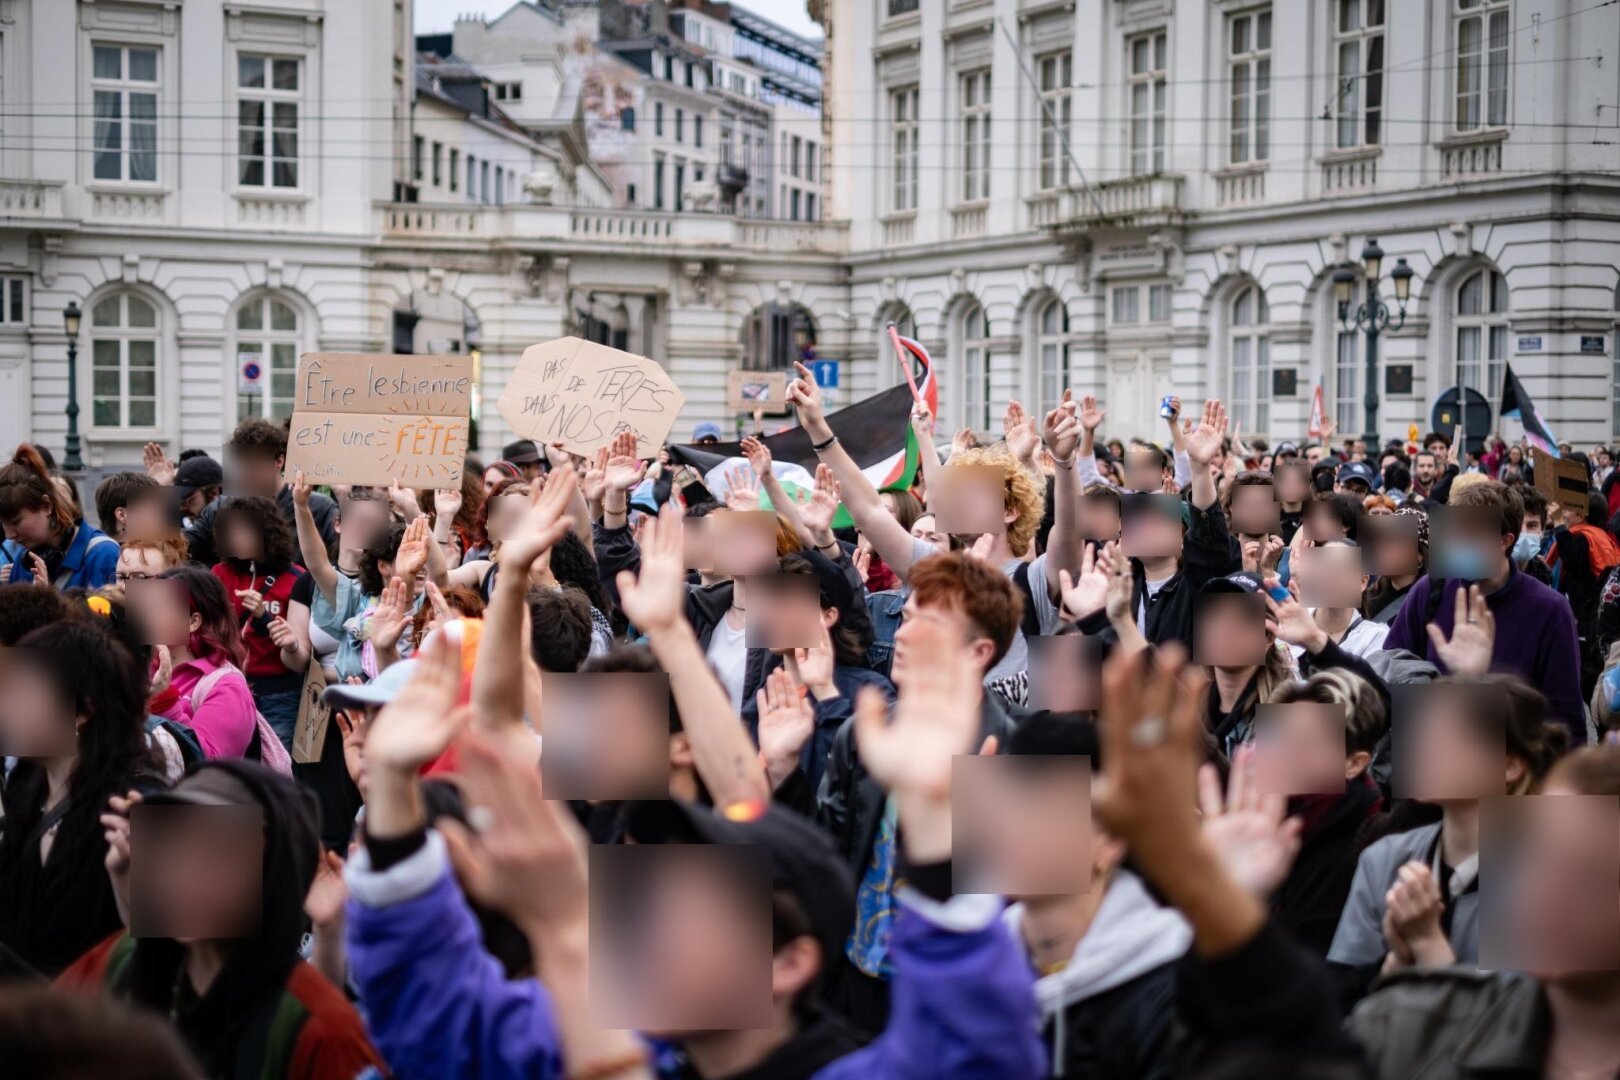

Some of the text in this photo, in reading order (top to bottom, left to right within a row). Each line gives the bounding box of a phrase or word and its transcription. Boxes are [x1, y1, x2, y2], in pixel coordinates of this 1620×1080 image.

[306, 361, 469, 405] Être lesbienne
[543, 359, 674, 412] PAS DE TERFS
[296, 417, 461, 455] est une FÊTE
[520, 394, 560, 415] DANS
[548, 404, 616, 443] NOS
